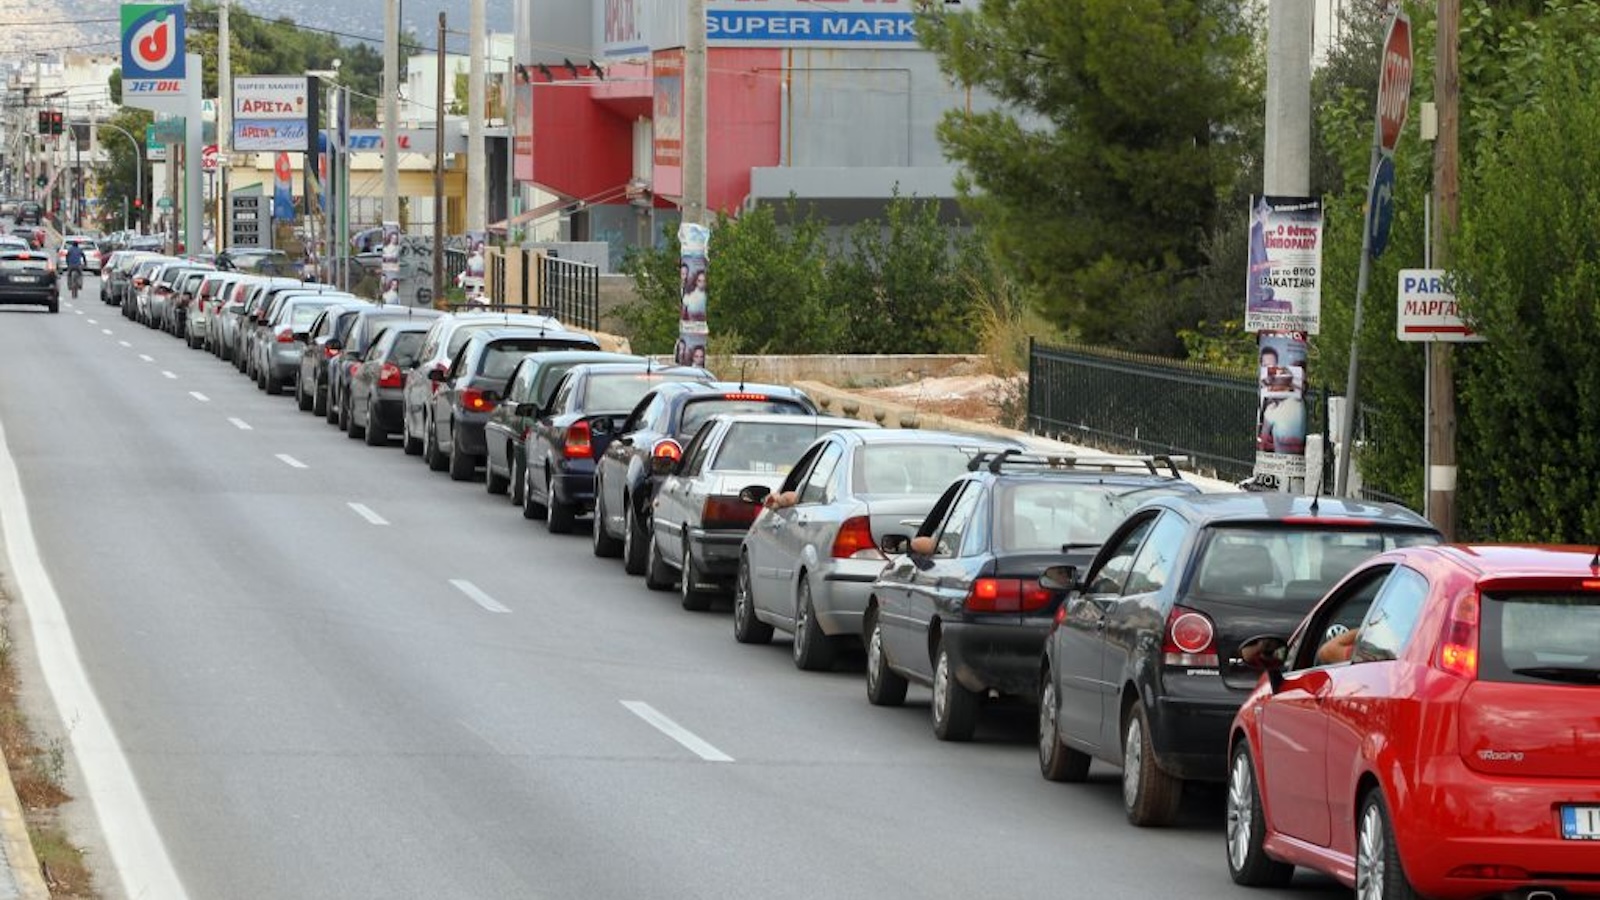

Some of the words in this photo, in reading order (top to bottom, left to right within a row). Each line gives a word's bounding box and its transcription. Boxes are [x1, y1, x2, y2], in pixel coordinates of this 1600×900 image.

[706, 17, 811, 34] SUPER
[822, 18, 918, 36] MARK
[129, 80, 181, 92] JETOIL
[1381, 51, 1408, 121] STOP
[242, 99, 293, 113] ΑΡΙΣΤΑ
